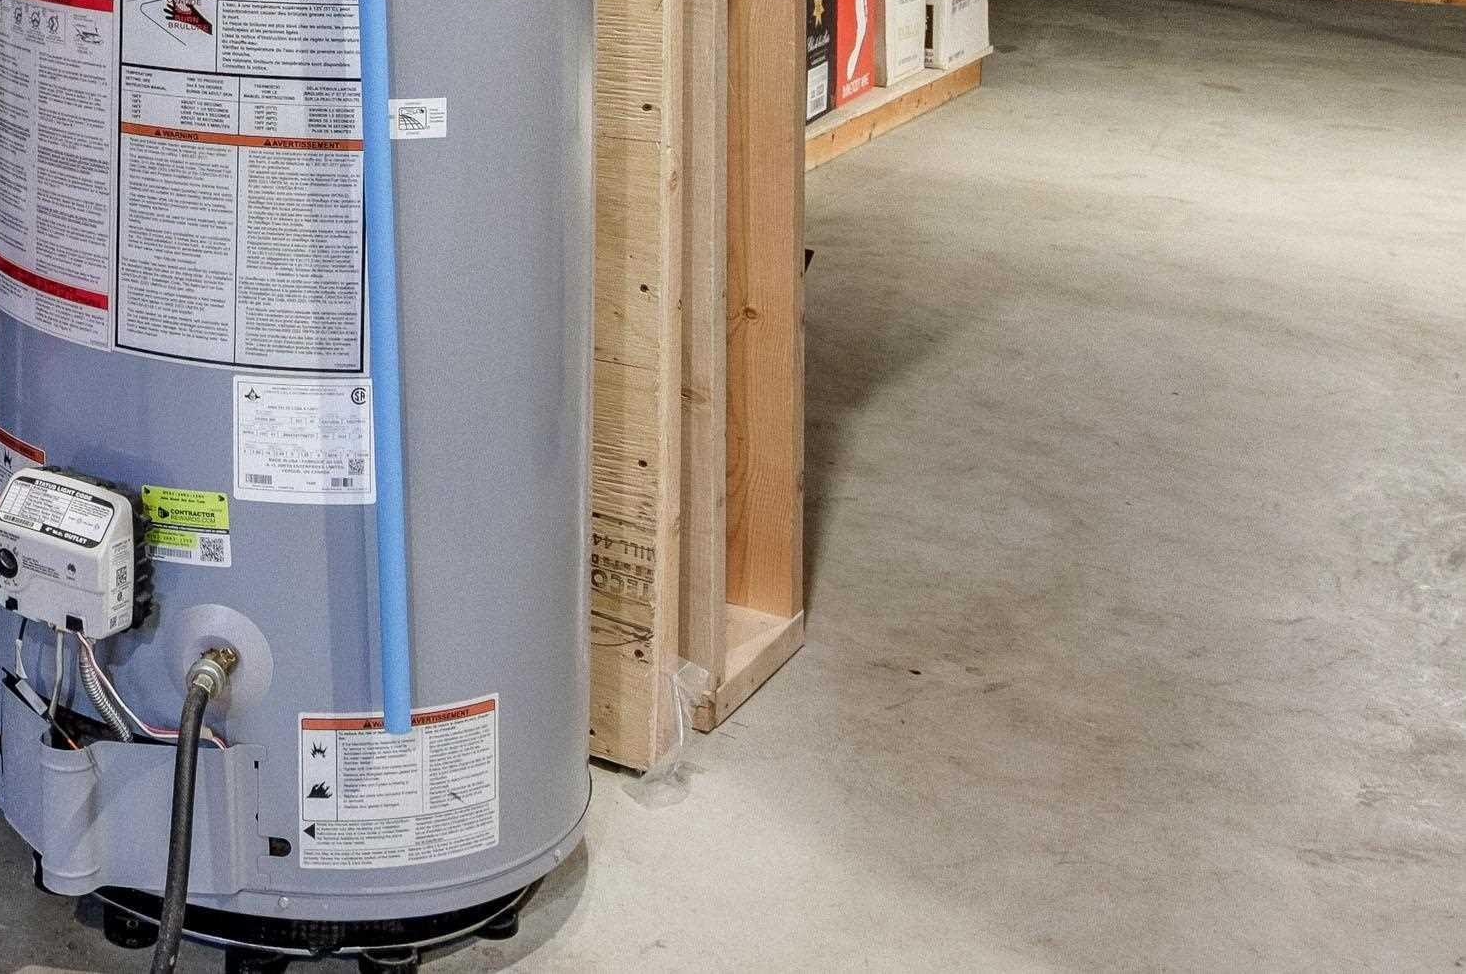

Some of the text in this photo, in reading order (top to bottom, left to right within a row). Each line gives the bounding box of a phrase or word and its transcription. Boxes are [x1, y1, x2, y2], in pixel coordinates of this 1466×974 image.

[162, 131, 340, 148] WARNING AVERTISSEMENT
[35, 480, 56, 490] STATUS
[57, 486, 75, 496] LIGHT
[170, 509, 215, 517] CONTRACTOR
[64, 533, 87, 544] OUTLET
